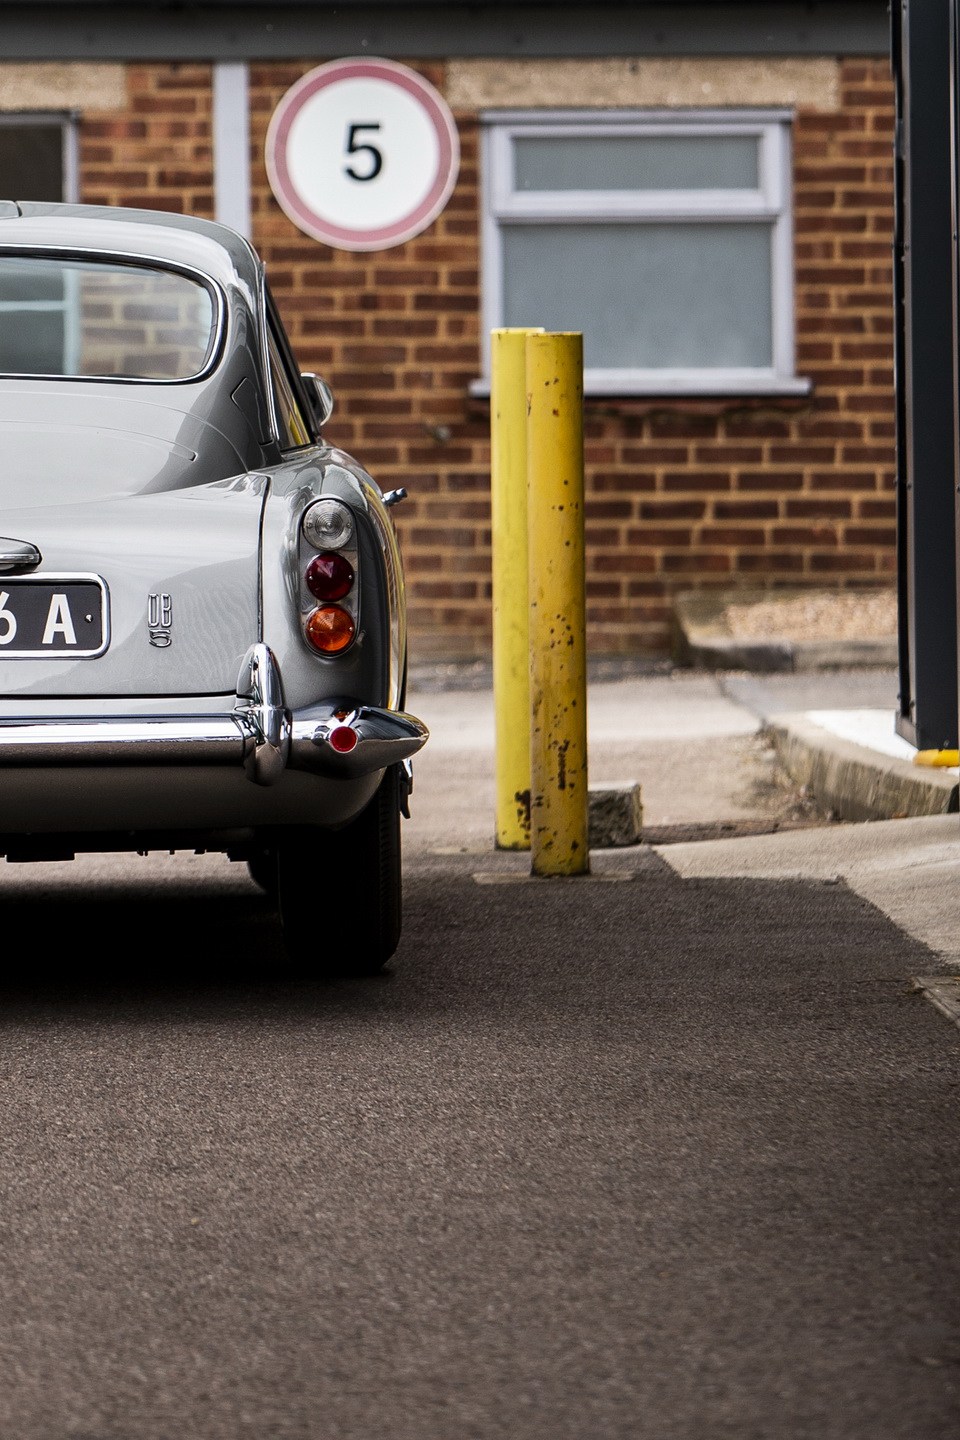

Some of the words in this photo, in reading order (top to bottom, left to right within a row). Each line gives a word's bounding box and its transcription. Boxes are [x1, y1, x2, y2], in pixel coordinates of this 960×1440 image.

[344, 122, 383, 182] 5
[42, 593, 78, 645] A
[148, 593, 172, 627] DB
[148, 629, 172, 648] 5
